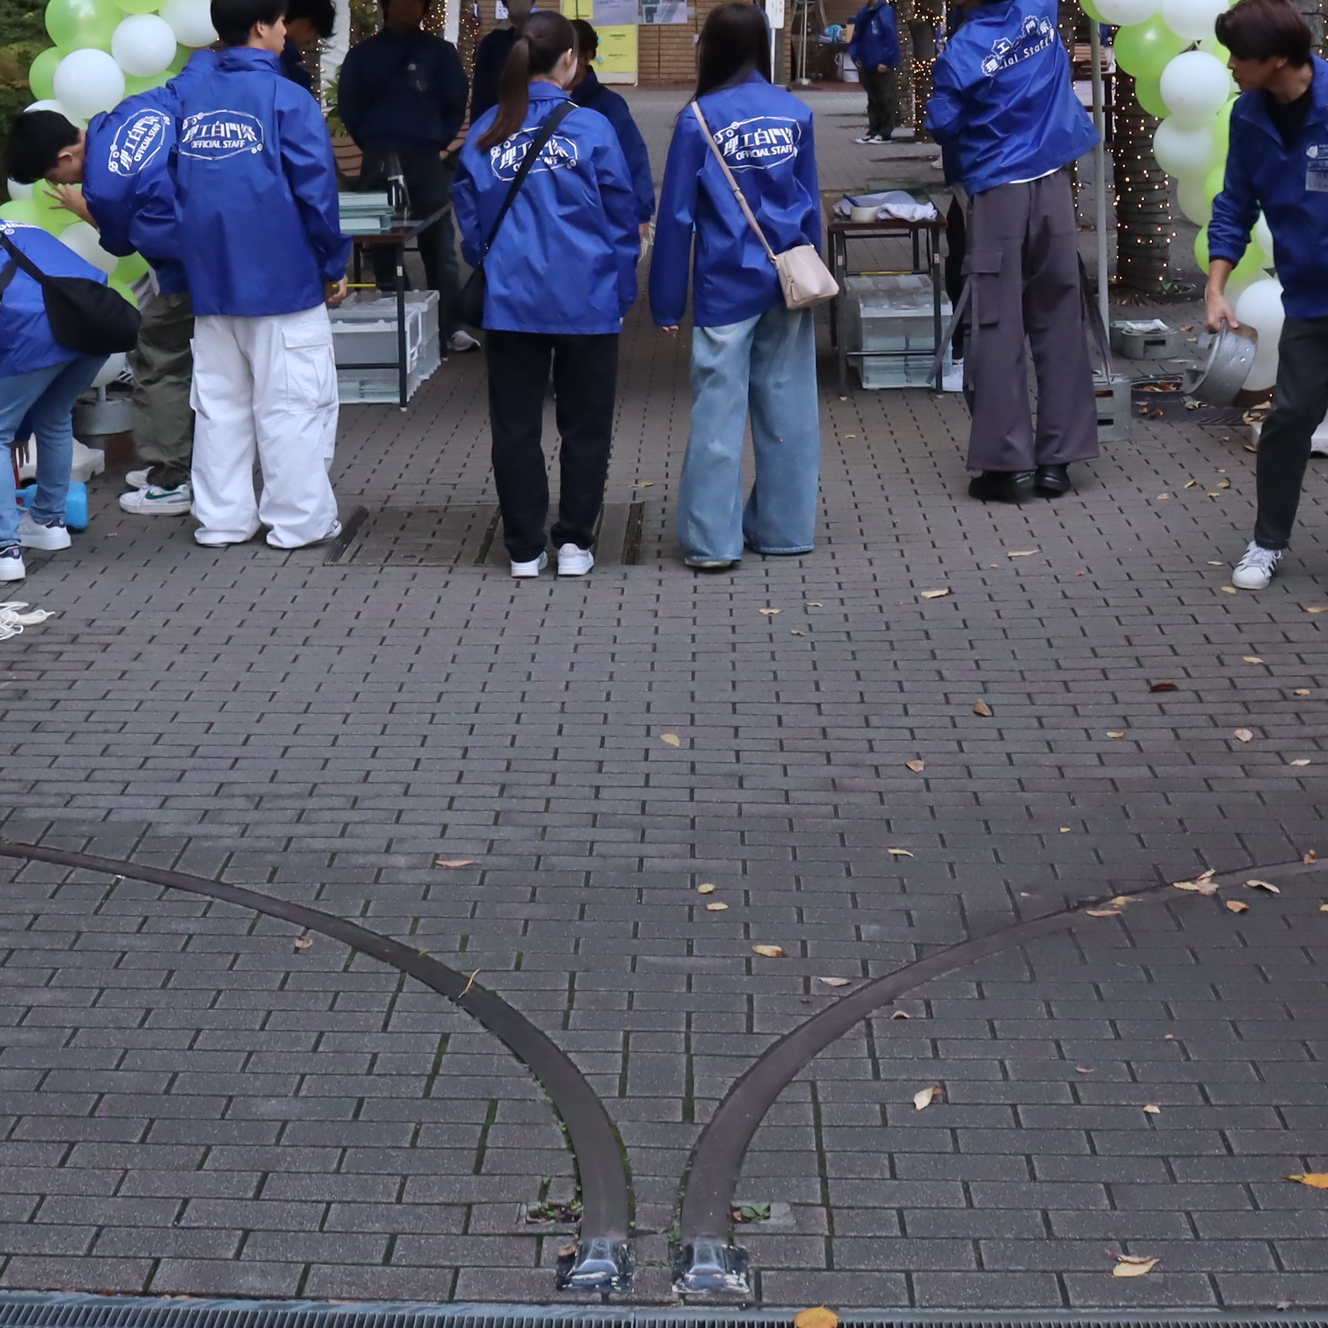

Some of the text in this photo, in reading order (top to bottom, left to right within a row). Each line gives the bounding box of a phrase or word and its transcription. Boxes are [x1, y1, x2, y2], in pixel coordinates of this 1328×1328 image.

[191, 139, 246, 149] OFFICIAL STAFF
[735, 148, 770, 161] OFFICIAL
